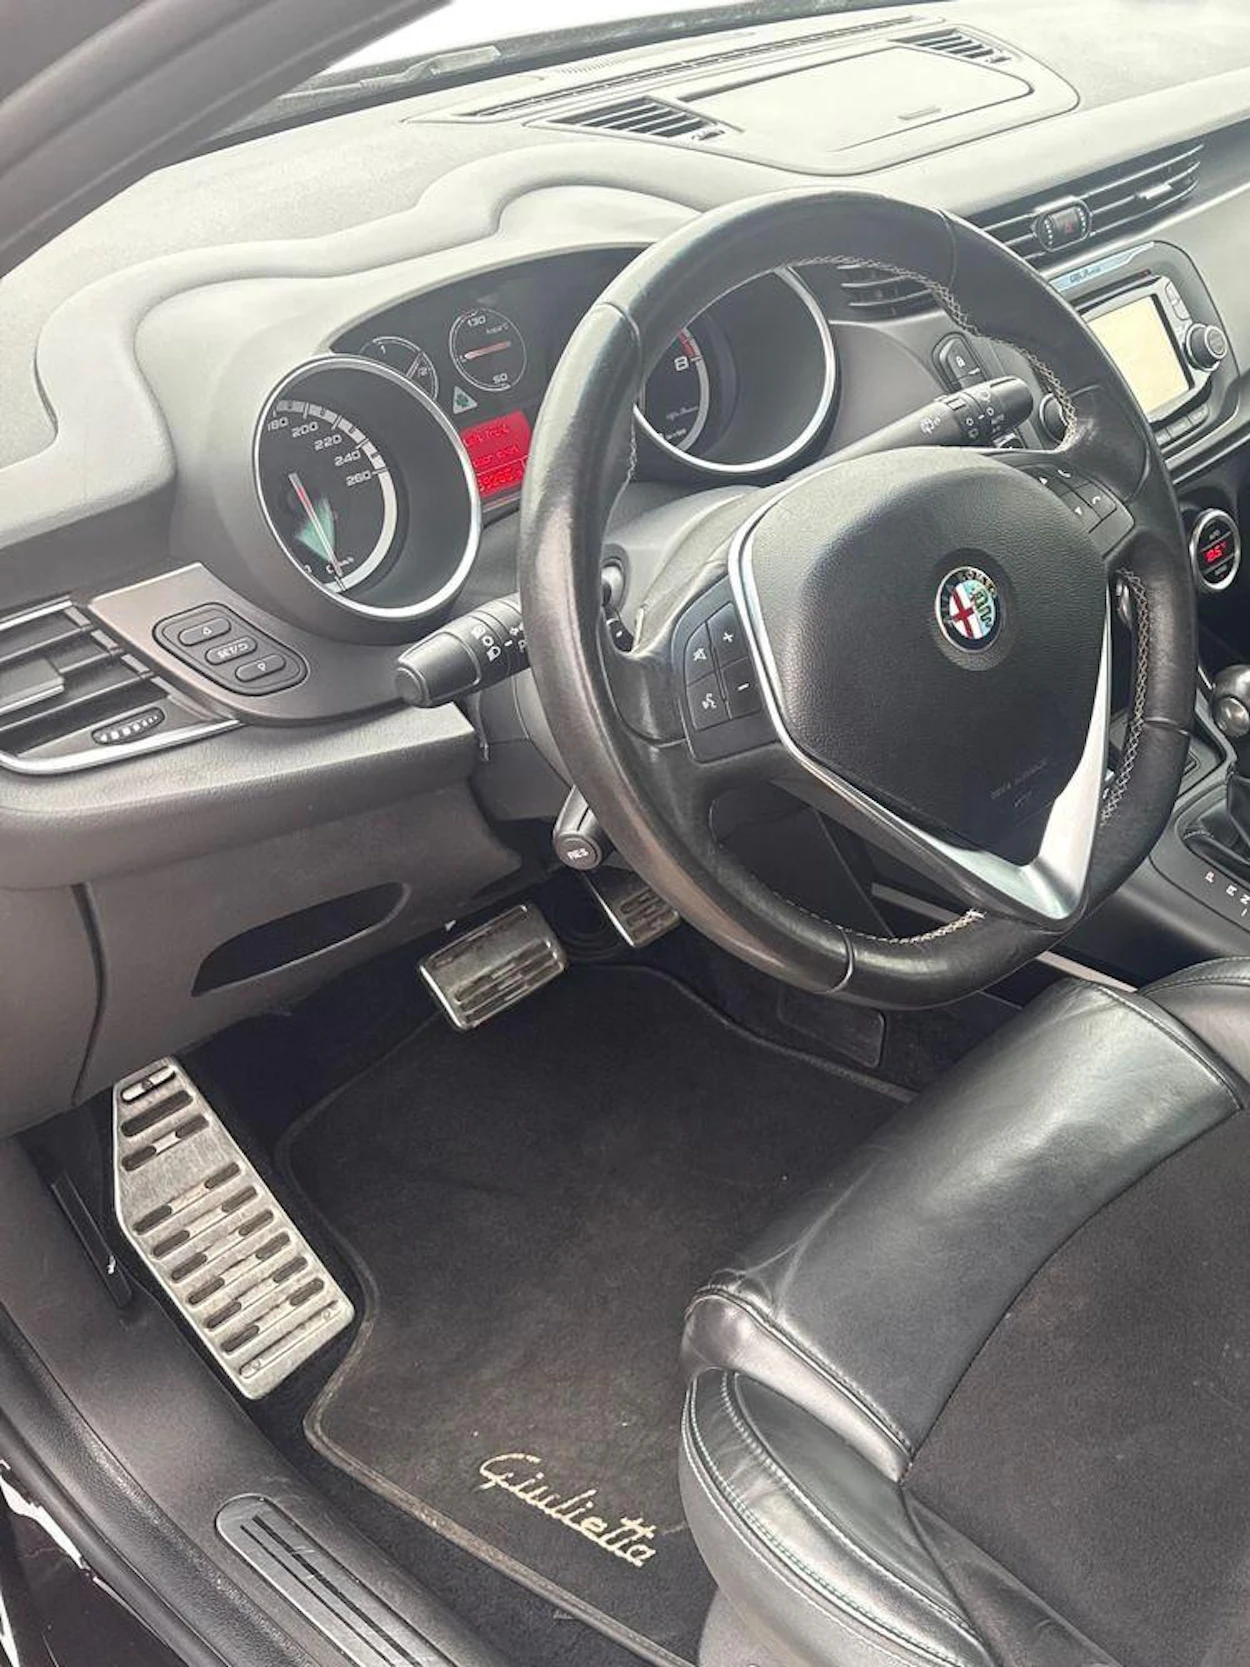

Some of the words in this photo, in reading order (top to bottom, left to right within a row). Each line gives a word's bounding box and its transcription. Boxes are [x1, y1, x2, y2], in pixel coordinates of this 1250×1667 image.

[673, 355, 690, 372] 8
[267, 416, 289, 431] 180
[291, 421, 319, 438] 200
[314, 433, 342, 451] 220
[334, 449, 361, 467] 240
[346, 470, 372, 487] 260
[479, 1453, 657, 1568] Giulietta
